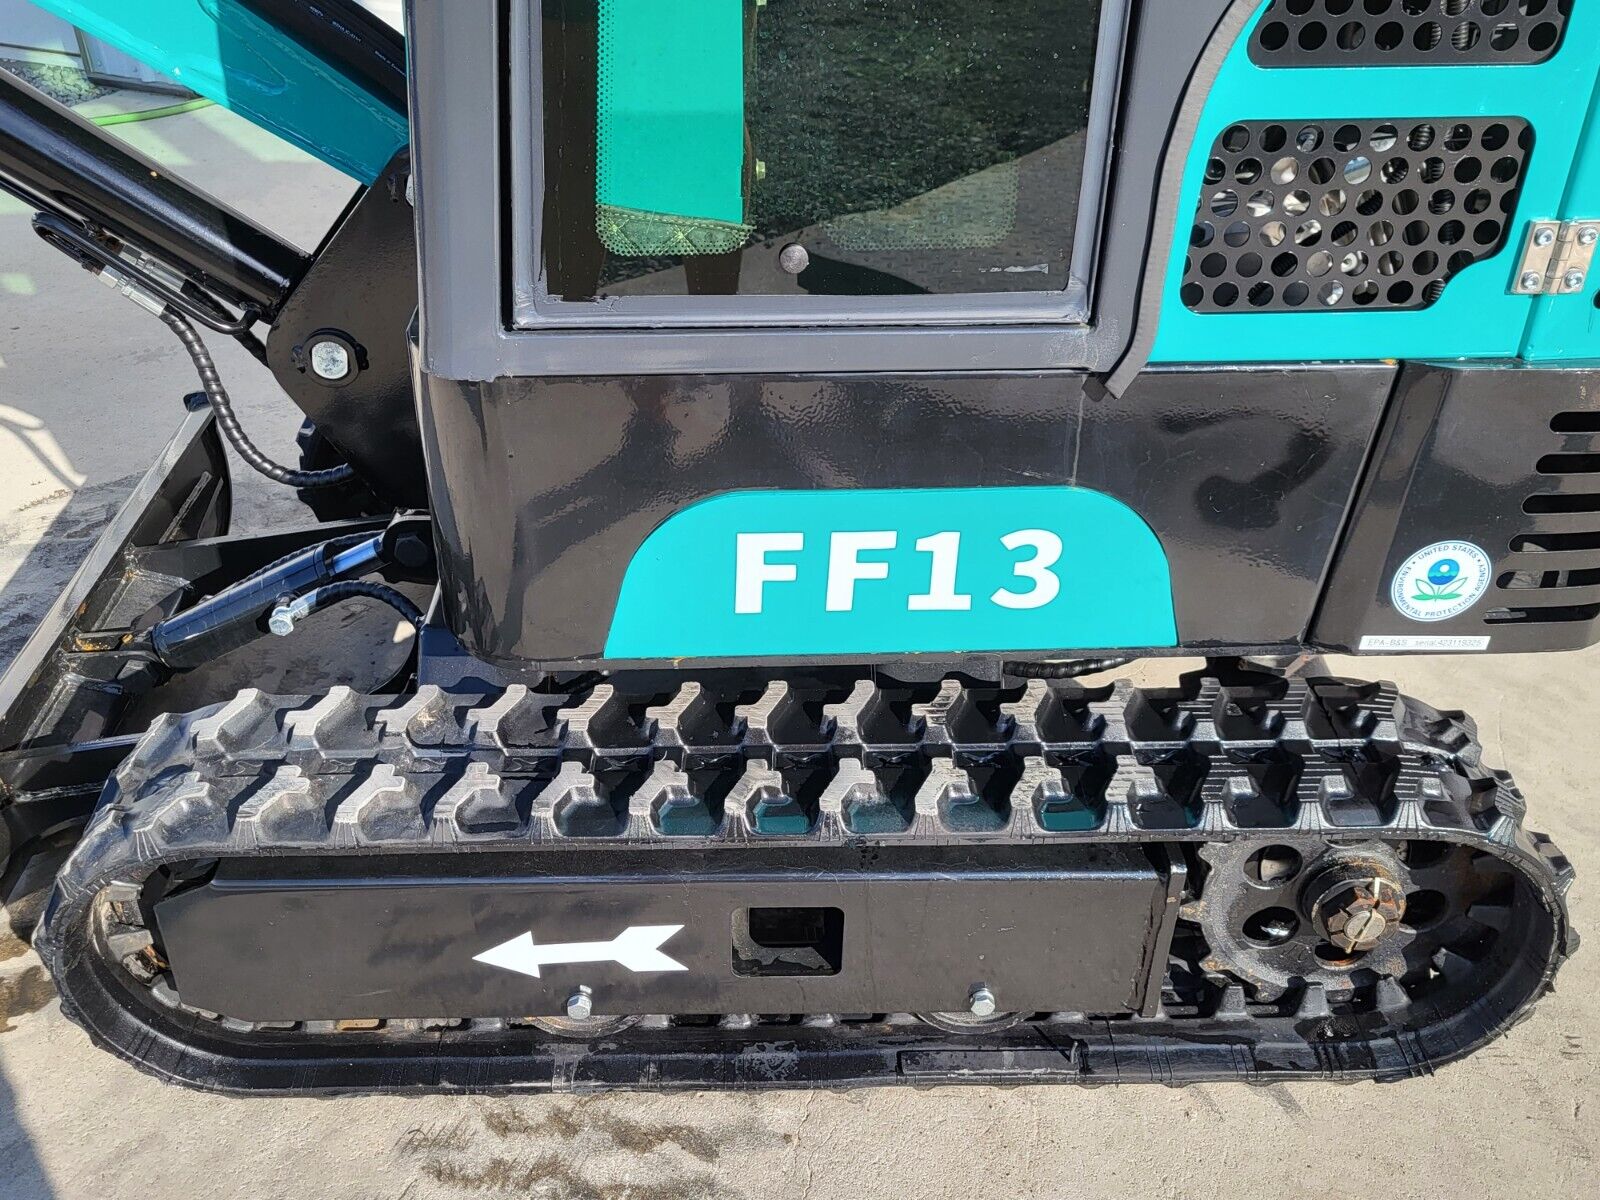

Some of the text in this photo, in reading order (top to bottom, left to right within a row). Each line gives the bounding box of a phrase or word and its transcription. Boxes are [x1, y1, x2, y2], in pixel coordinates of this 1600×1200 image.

[734, 529, 1064, 614] FF13
[1418, 544, 1479, 560] UNITED STATES
[1394, 564, 1487, 617] ENVIRONMENTAL PROTECTION AGENCY
